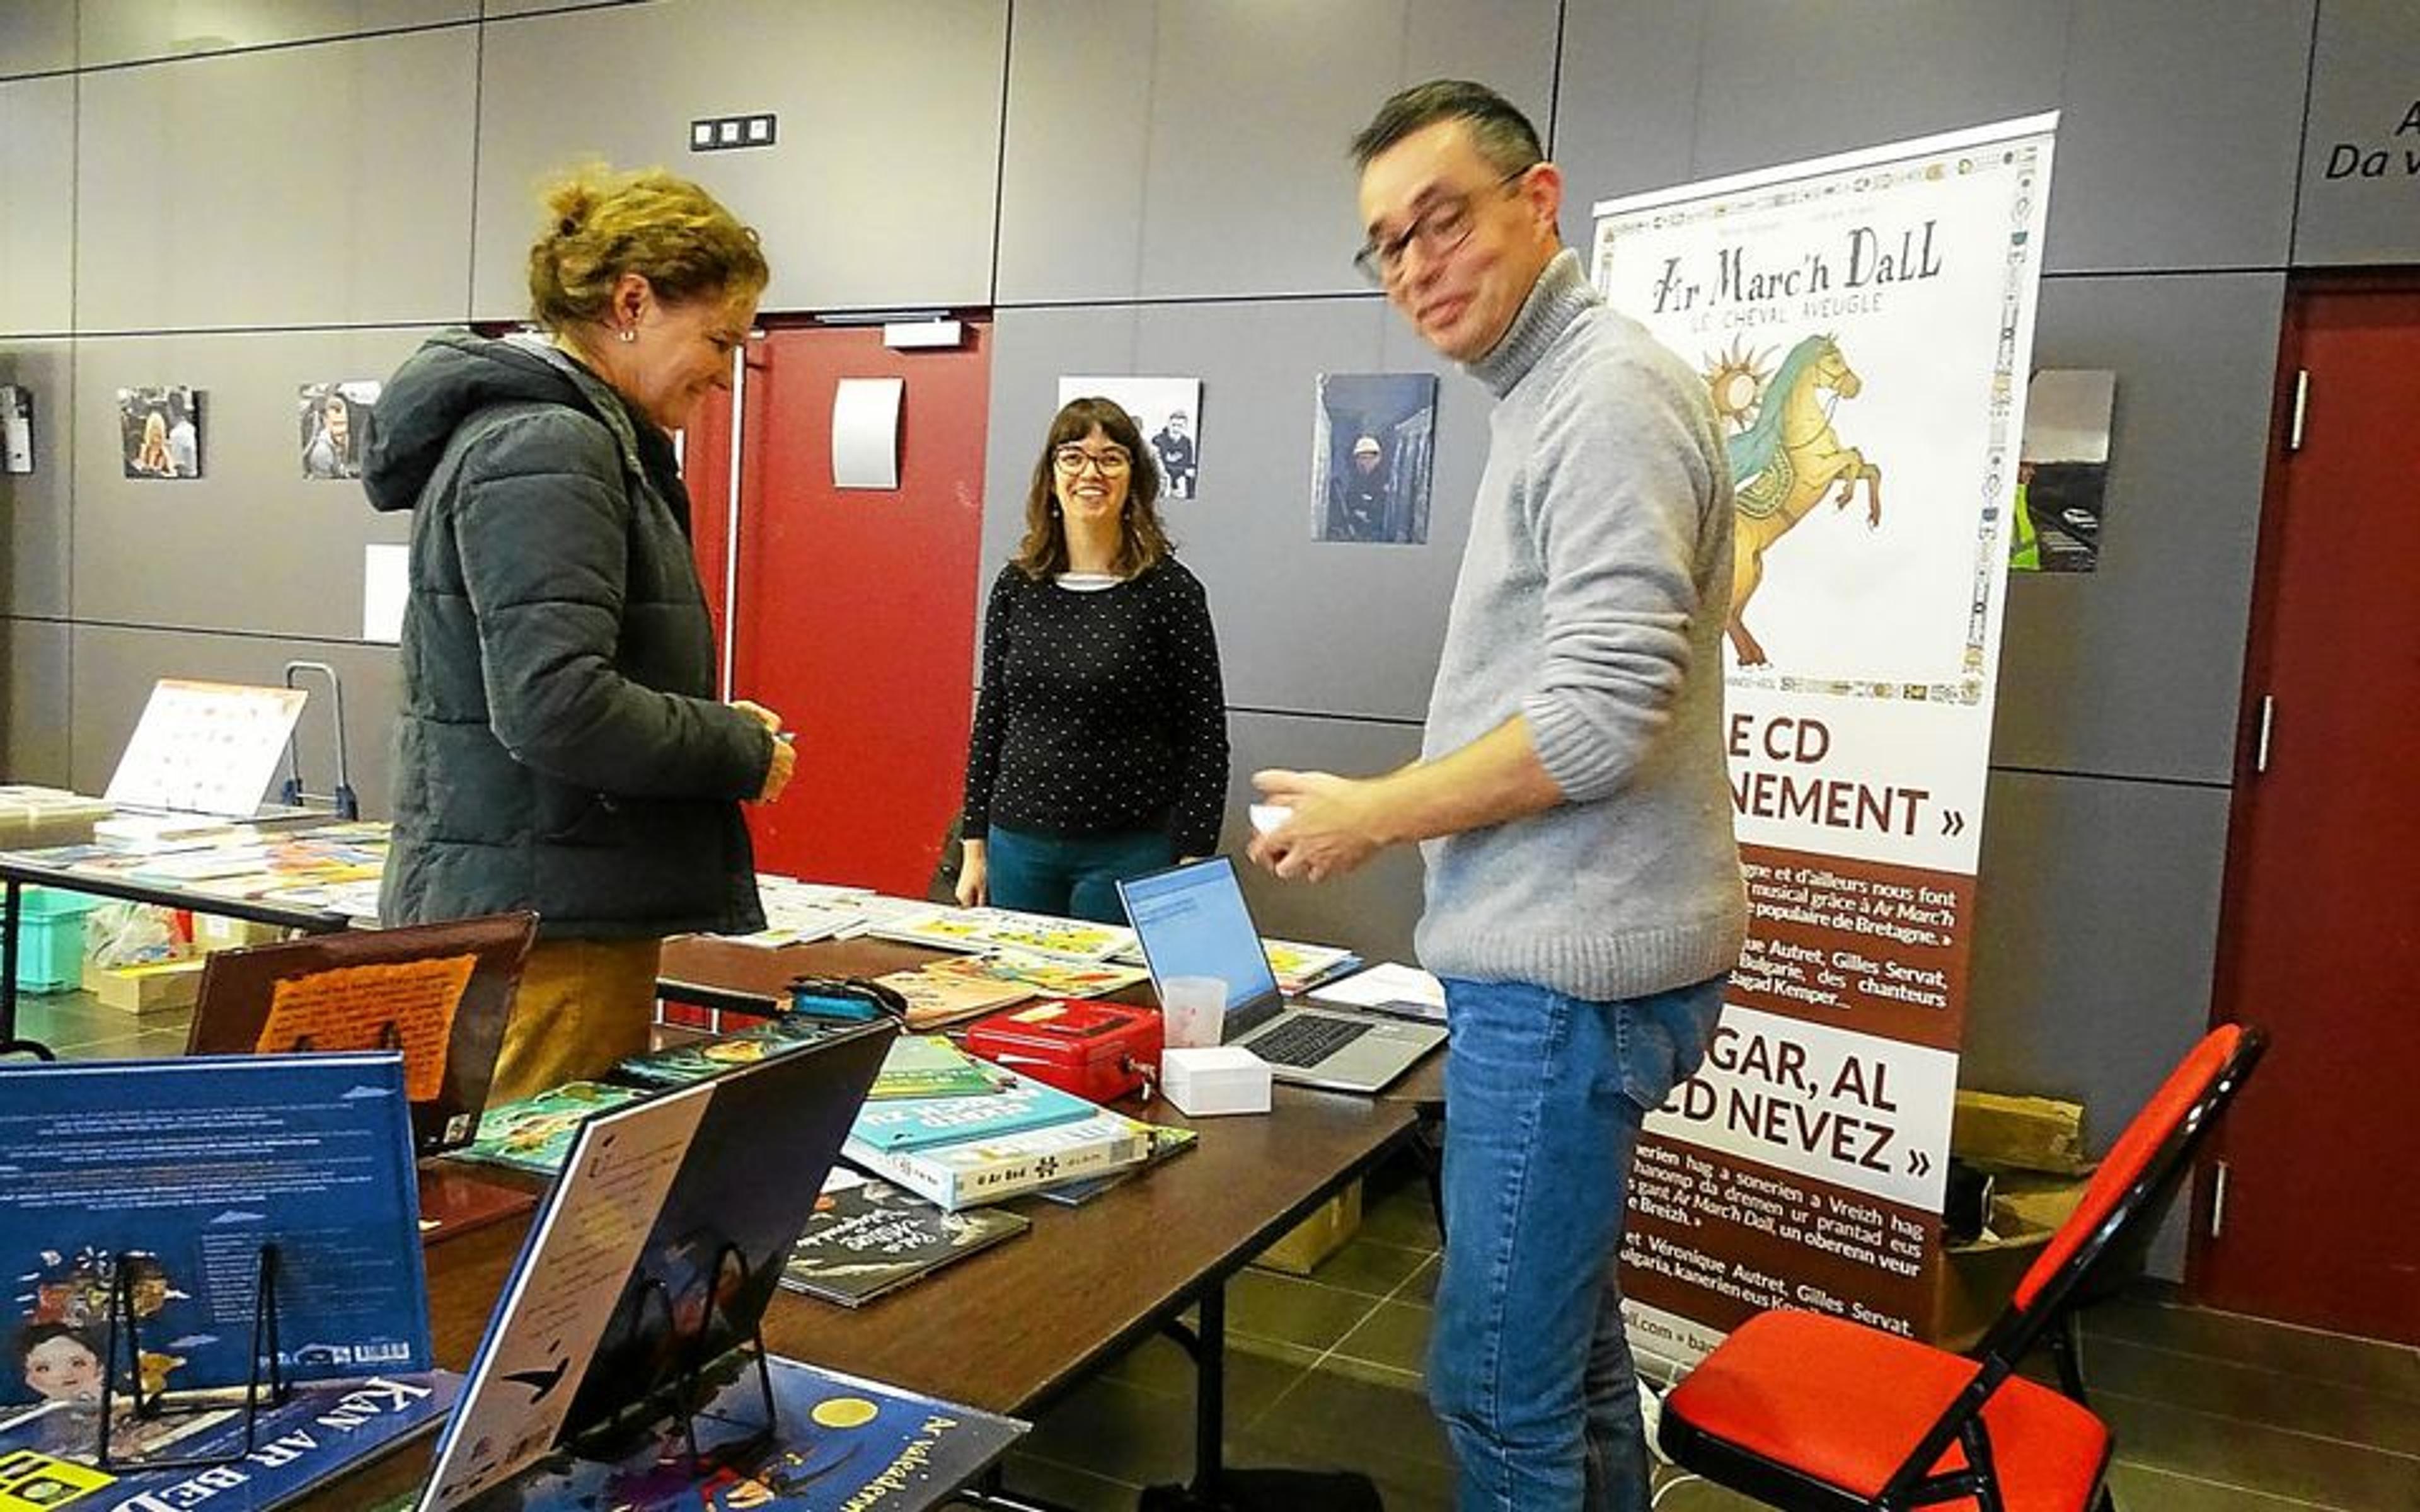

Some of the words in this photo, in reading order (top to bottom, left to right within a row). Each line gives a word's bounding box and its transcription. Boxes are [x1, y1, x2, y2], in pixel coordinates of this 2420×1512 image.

[2325, 144, 2389, 180] Da
[1708, 246, 1829, 307] Marc'h
[1723, 307, 1788, 328] CHEVAL
[1802, 292, 1884, 319] AVEUGLE
[1729, 713, 1754, 757] E
[1764, 716, 1831, 764] CD
[1751, 883, 1809, 903] musical
[1774, 867, 1792, 881] et
[1796, 867, 1868, 893] d'ailleurs
[1872, 883, 1915, 902] nous
[1918, 886, 1957, 907] font
[1756, 902, 1831, 928] populaire
[1832, 912, 1854, 931] de
[1742, 939, 1765, 953] ue
[1832, 951, 1880, 975] Gilles
[1885, 961, 1948, 990] Servat,
[1817, 970, 1847, 989] des
[1858, 976, 1947, 1009] chanteurs
[1830, 1055, 1897, 1113] AL
[1659, 1077, 1718, 1123] D
[1727, 1087, 1896, 1174] NEVEZ
[1698, 1178, 1719, 1197] da
[1724, 1186, 1783, 1216] dremen
[1790, 1209, 1809, 1225] ur
[1817, 1214, 1882, 1247] prantad
[1890, 1240, 1922, 1259] eus
[1736, 1171, 1804, 1205] sonerien
[1828, 1196, 1882, 1227] Vreizh
[1891, 1213, 1925, 1243] hag
[1647, 1234, 1726, 1276] Véronique
[1797, 1284, 1845, 1314] Gilles
[1780, 1225, 1802, 1242] un
[1804, 1229, 1875, 1264] oberenn
[1879, 1257, 1922, 1279] veur
[1674, 1265, 1741, 1301] kanerien
[316, 1376, 432, 1433] KAN
[245, 1428, 318, 1469] AR
